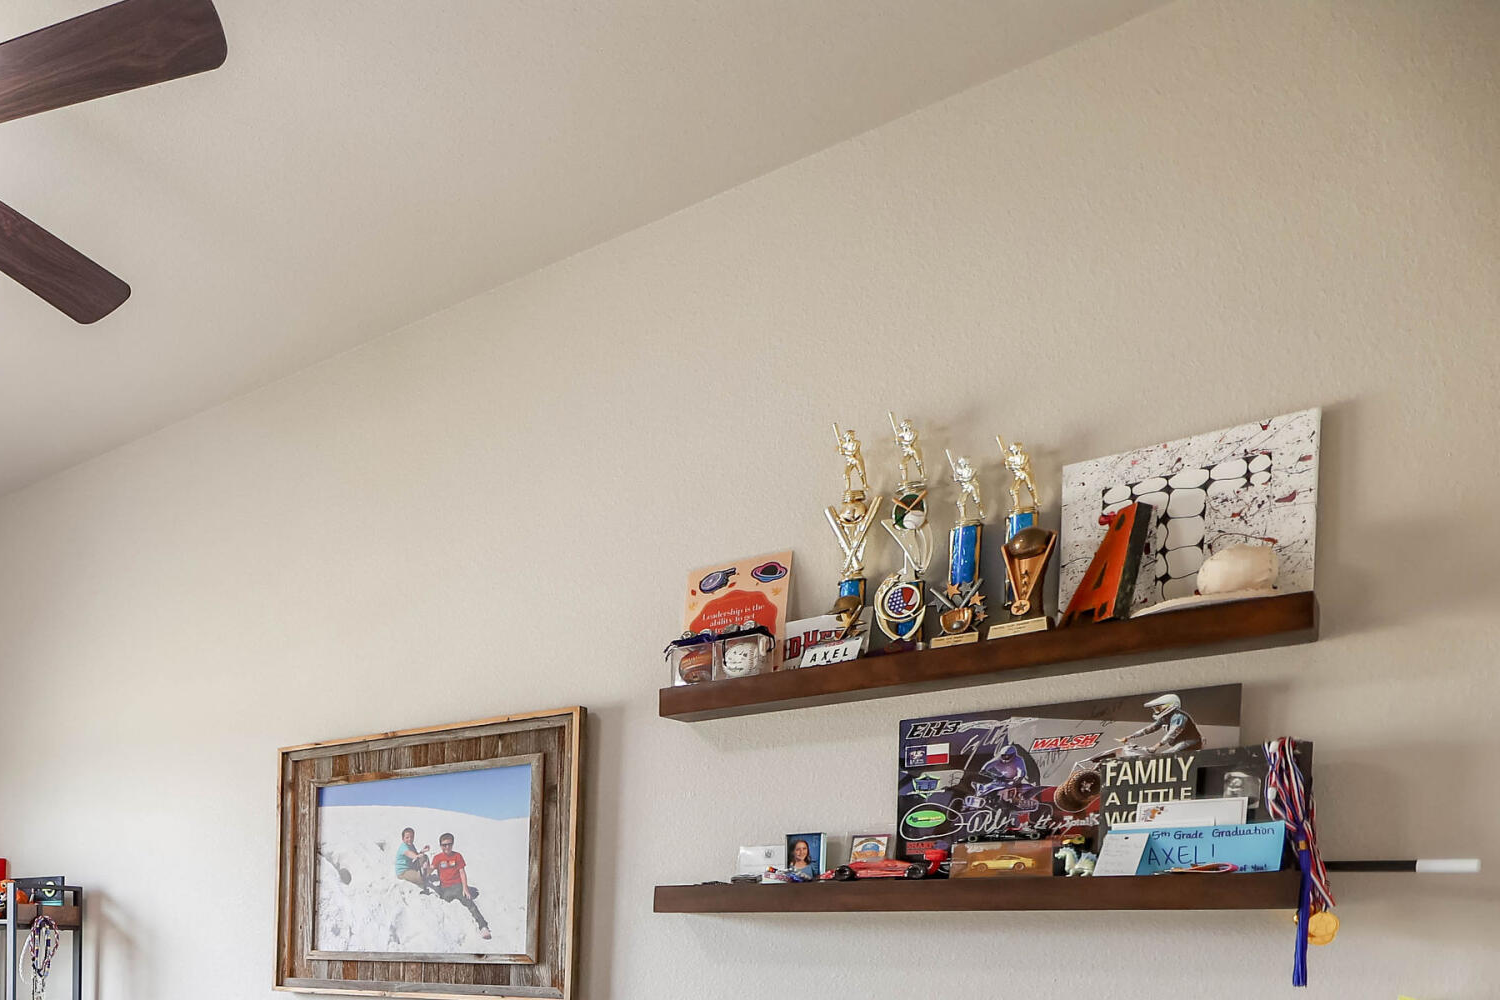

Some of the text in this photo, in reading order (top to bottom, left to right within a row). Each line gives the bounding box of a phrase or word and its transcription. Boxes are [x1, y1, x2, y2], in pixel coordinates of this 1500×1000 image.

[702, 608, 743, 621] Leadership
[752, 603, 765, 611] the
[709, 616, 733, 627] ability
[809, 647, 849, 664] AXEL
[1032, 733, 1101, 750] WALSH
[1102, 756, 1195, 787] FAMILY
[1105, 787, 1192, 806] A LITTLE
[1173, 830, 1204, 840] Grade
[1212, 826, 1275, 838] Graduation
